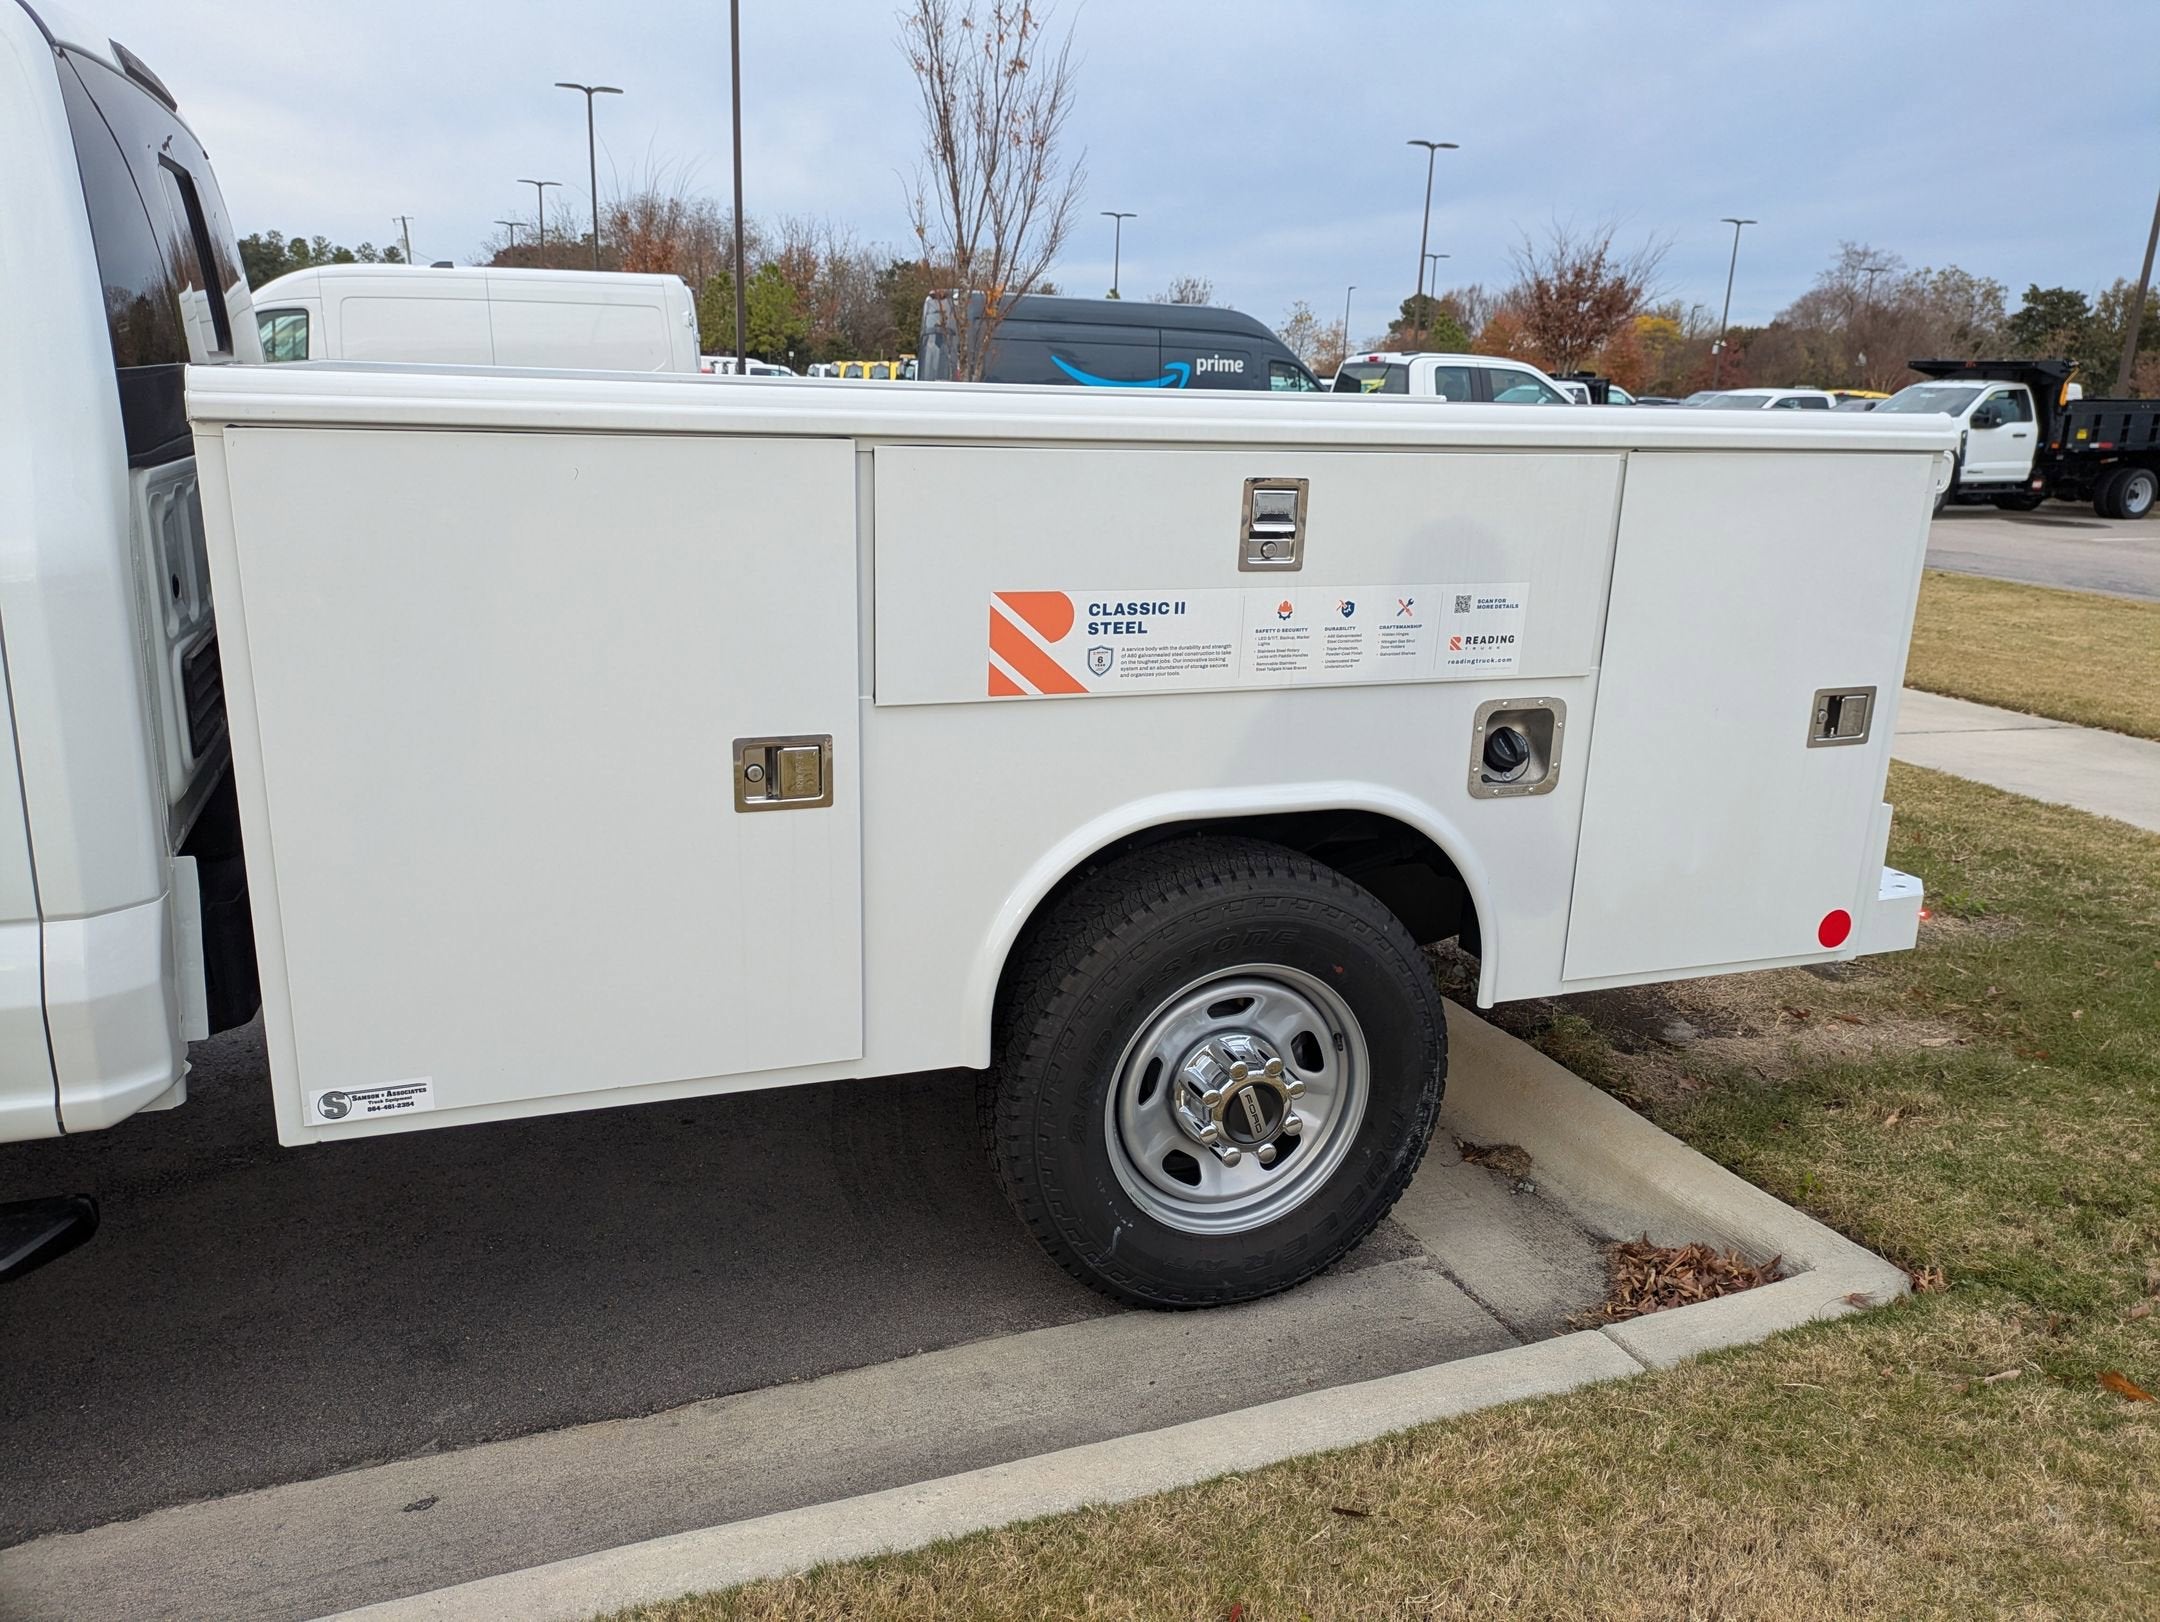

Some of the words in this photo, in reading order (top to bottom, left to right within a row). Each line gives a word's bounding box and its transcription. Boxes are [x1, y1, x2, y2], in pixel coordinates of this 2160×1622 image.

[1196, 354, 1244, 376] prime
[1088, 602, 1170, 616] CLASSIC
[1174, 602, 1186, 614] II
[1088, 621, 1148, 635] STEEL
[1466, 635, 1515, 644] READING
[1097, 656, 1104, 664] 6
[1070, 928, 1301, 1146] BRIDGESTONE
[352, 1094, 380, 1102] SAMSON
[386, 1088, 427, 1098] ASSOCIATES
[1244, 1094, 1262, 1134] FORD
